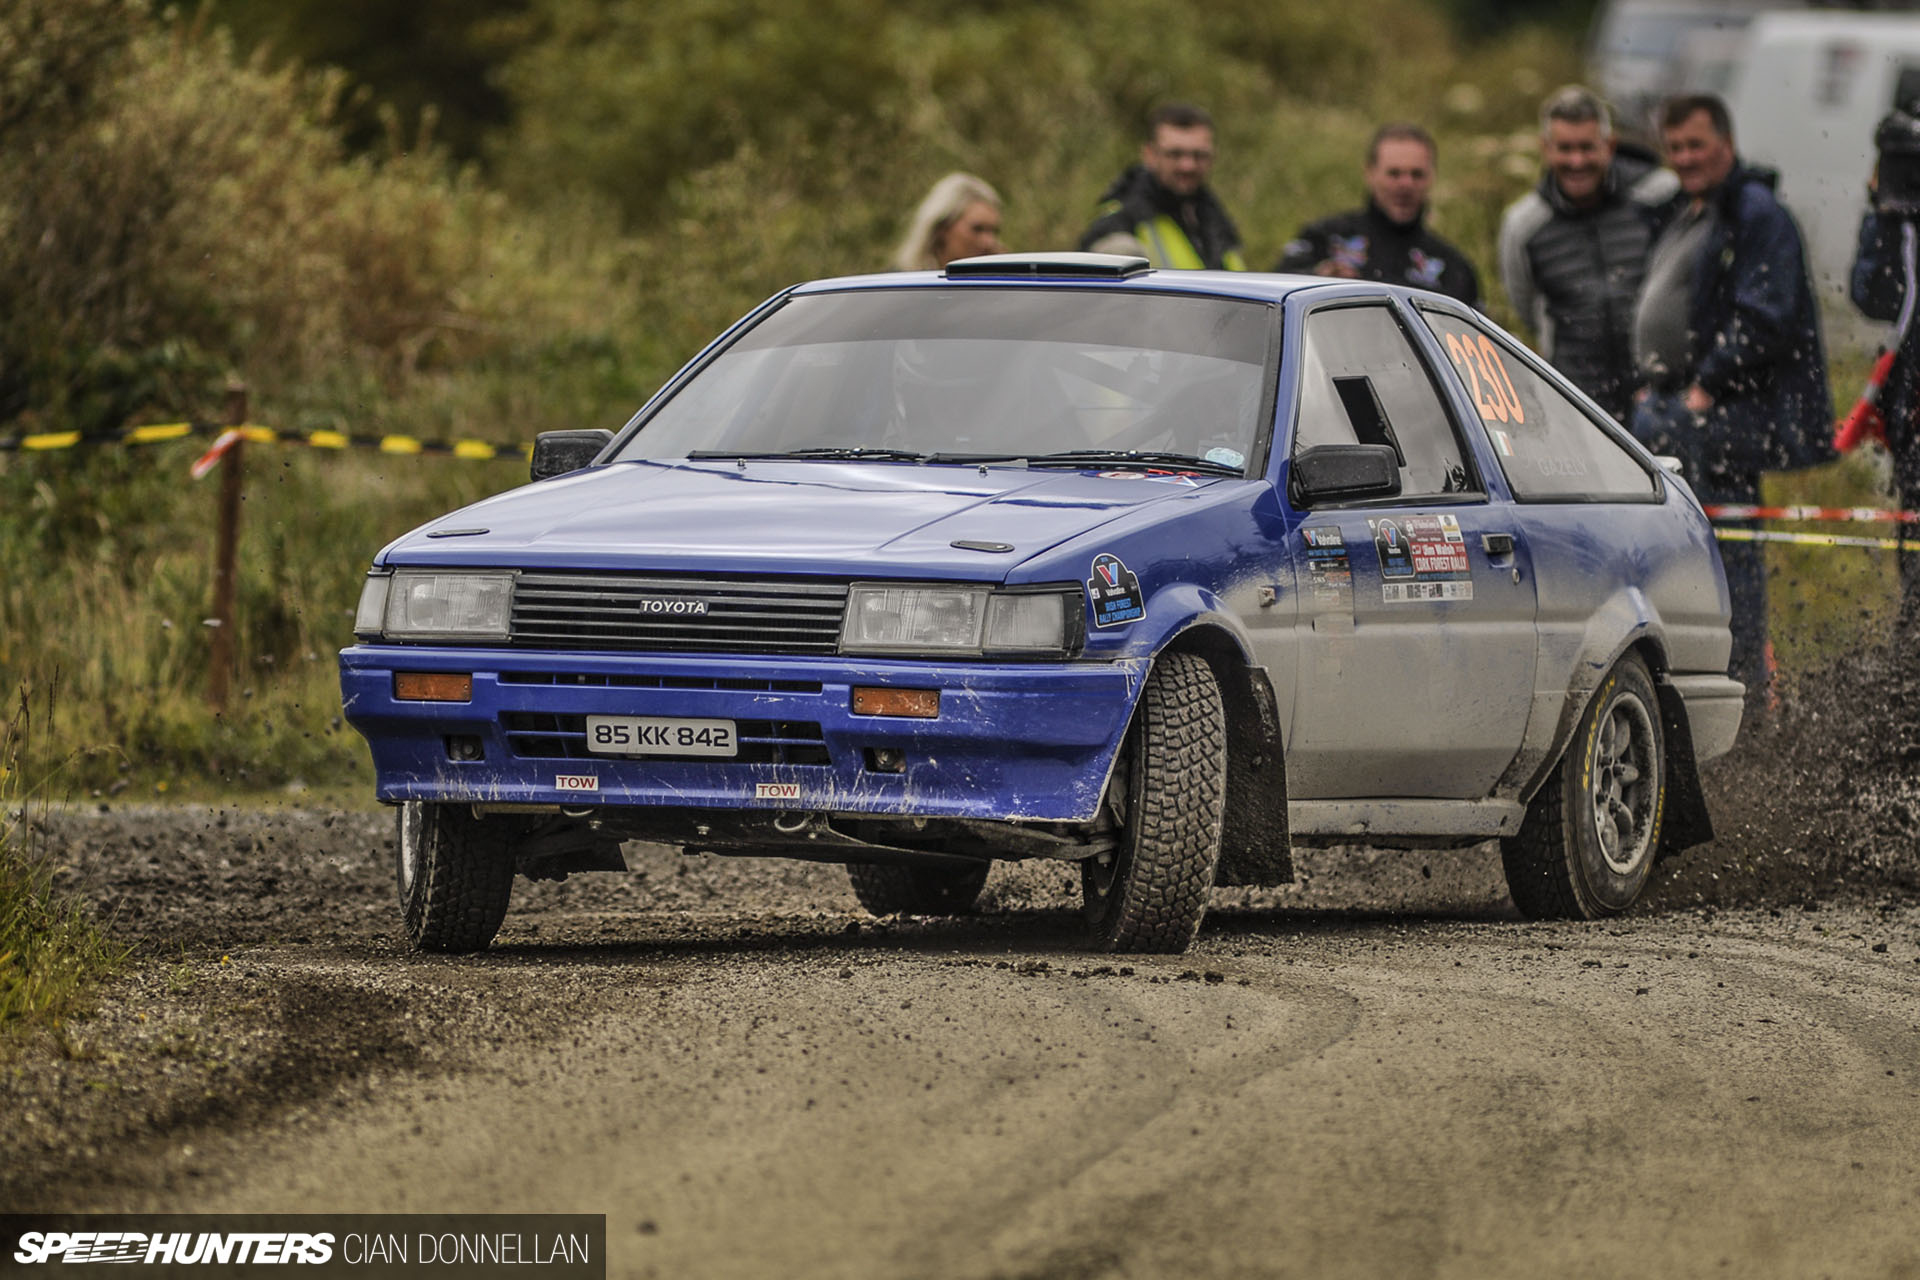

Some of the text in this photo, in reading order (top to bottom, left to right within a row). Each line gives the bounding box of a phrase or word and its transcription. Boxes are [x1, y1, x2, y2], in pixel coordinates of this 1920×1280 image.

[1446, 333, 1524, 424] 230
[1415, 557, 1430, 570] CORK
[1430, 556, 1450, 570] FOREST
[1450, 556, 1466, 570] RALLY
[641, 600, 705, 614] TOYOTA
[594, 725, 729, 747] 85 KK 842
[558, 777, 595, 788] TOW
[758, 785, 797, 797] TOW
